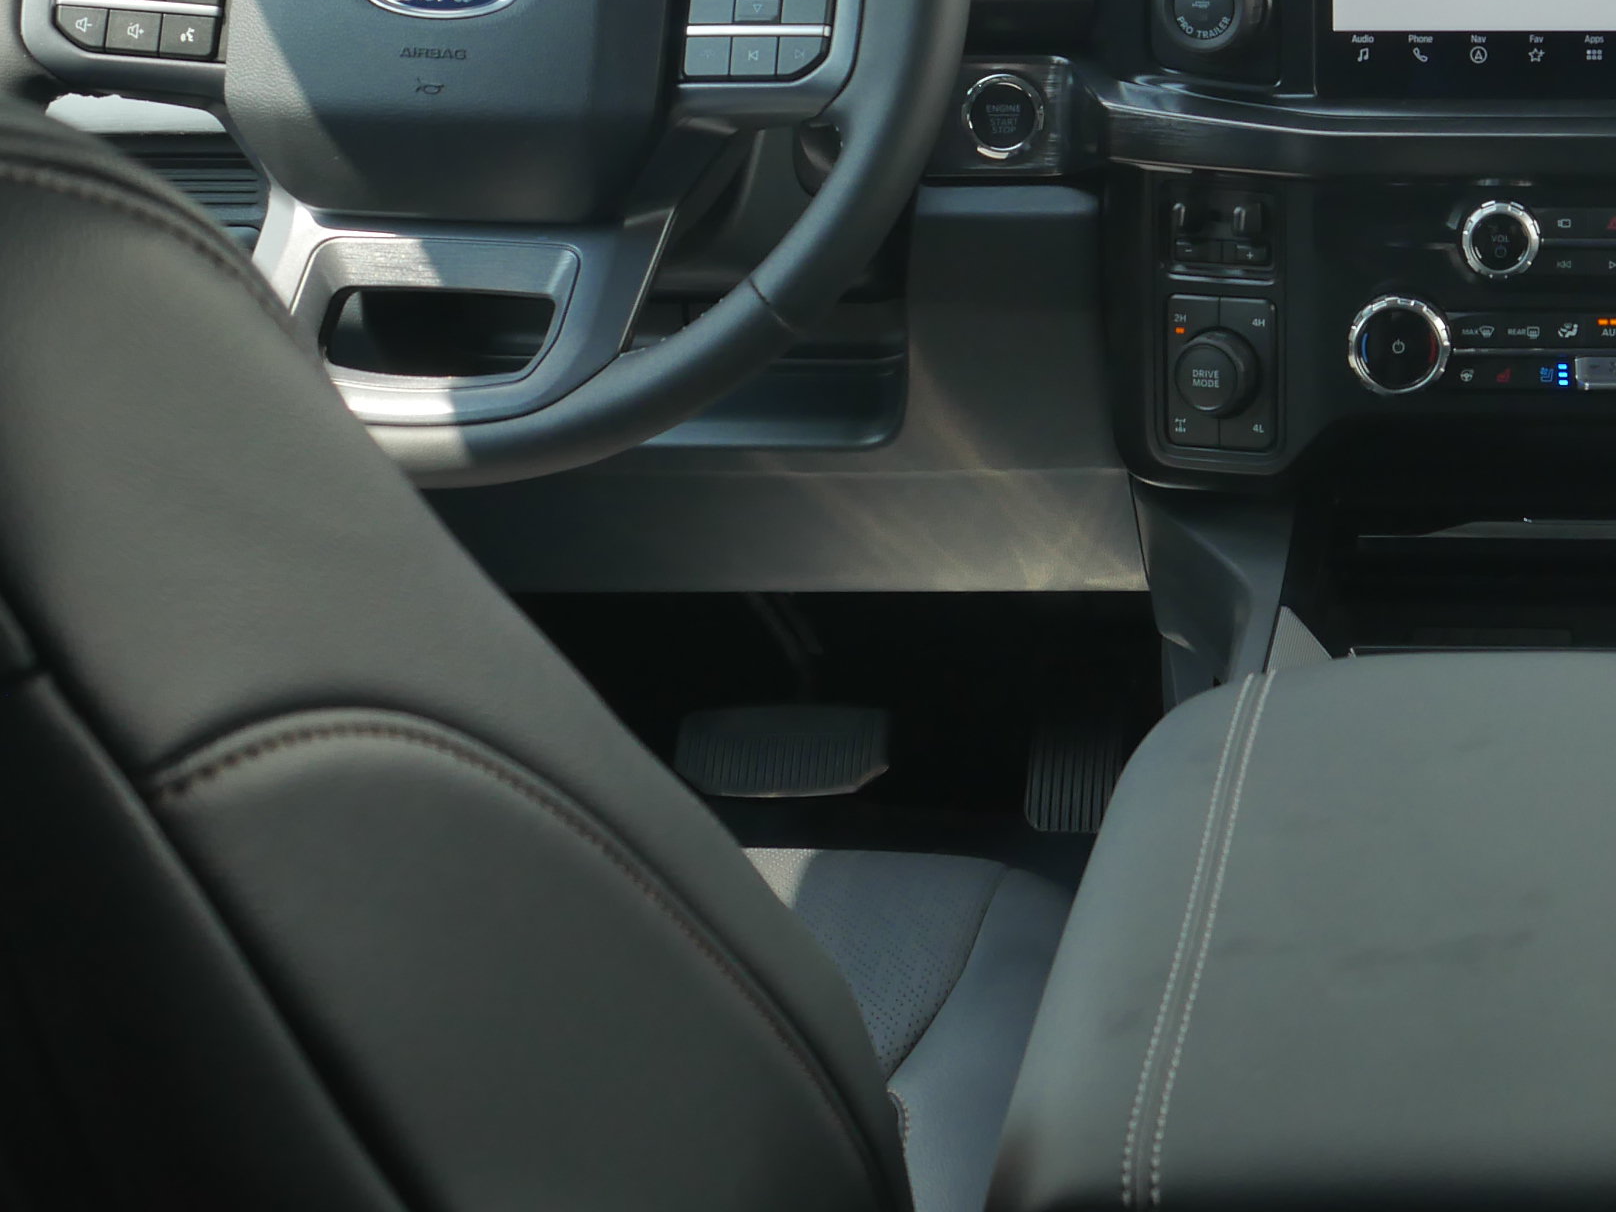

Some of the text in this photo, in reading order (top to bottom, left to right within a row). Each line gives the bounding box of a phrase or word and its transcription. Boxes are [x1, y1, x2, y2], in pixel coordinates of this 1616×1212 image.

[1196, 16, 1231, 38] TRAILER
[1351, 34, 1374, 43] Audio
[1408, 34, 1433, 43] Phone
[1471, 34, 1487, 43] Nav
[1529, 34, 1544, 43] Fav
[1584, 34, 1604, 44] Apps
[400, 47, 467, 60] AIRBAG
[1491, 234, 1510, 243] VOL
[1192, 369, 1220, 378] DRIVE
[1192, 379, 1220, 388] MODE
